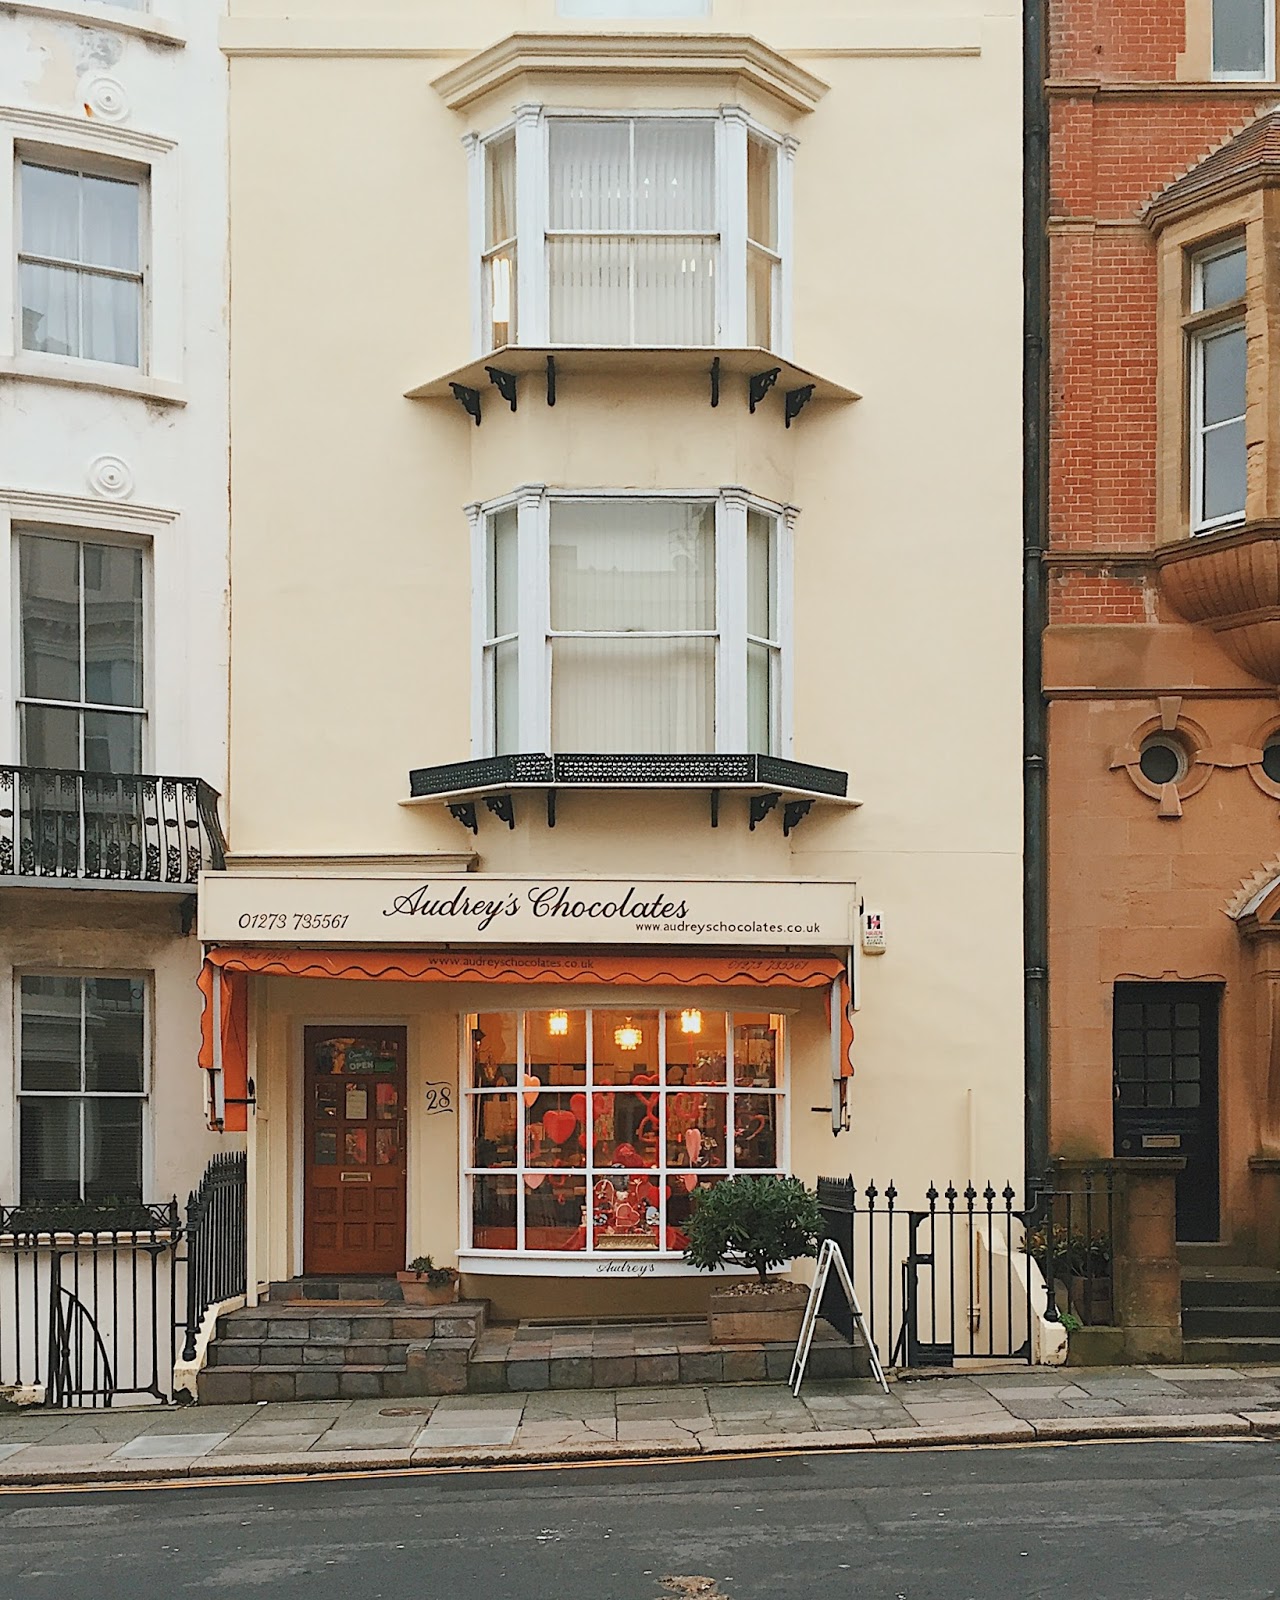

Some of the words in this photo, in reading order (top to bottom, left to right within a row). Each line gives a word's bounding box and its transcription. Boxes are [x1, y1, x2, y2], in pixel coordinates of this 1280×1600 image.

[382, 884, 521, 931] Audrey's
[528, 886, 689, 918] Chocolates
[238, 913, 287, 930] 01273
[293, 913, 349, 930] 735561
[635, 921, 821, 935] www.audreyschocolates.co.uk
[428, 957, 594, 969] www.audreyschocolates.co.uk
[350, 1061, 374, 1070] OPEN
[426, 1086, 451, 1111] 28
[596, 1260, 655, 1277] Audrey's
